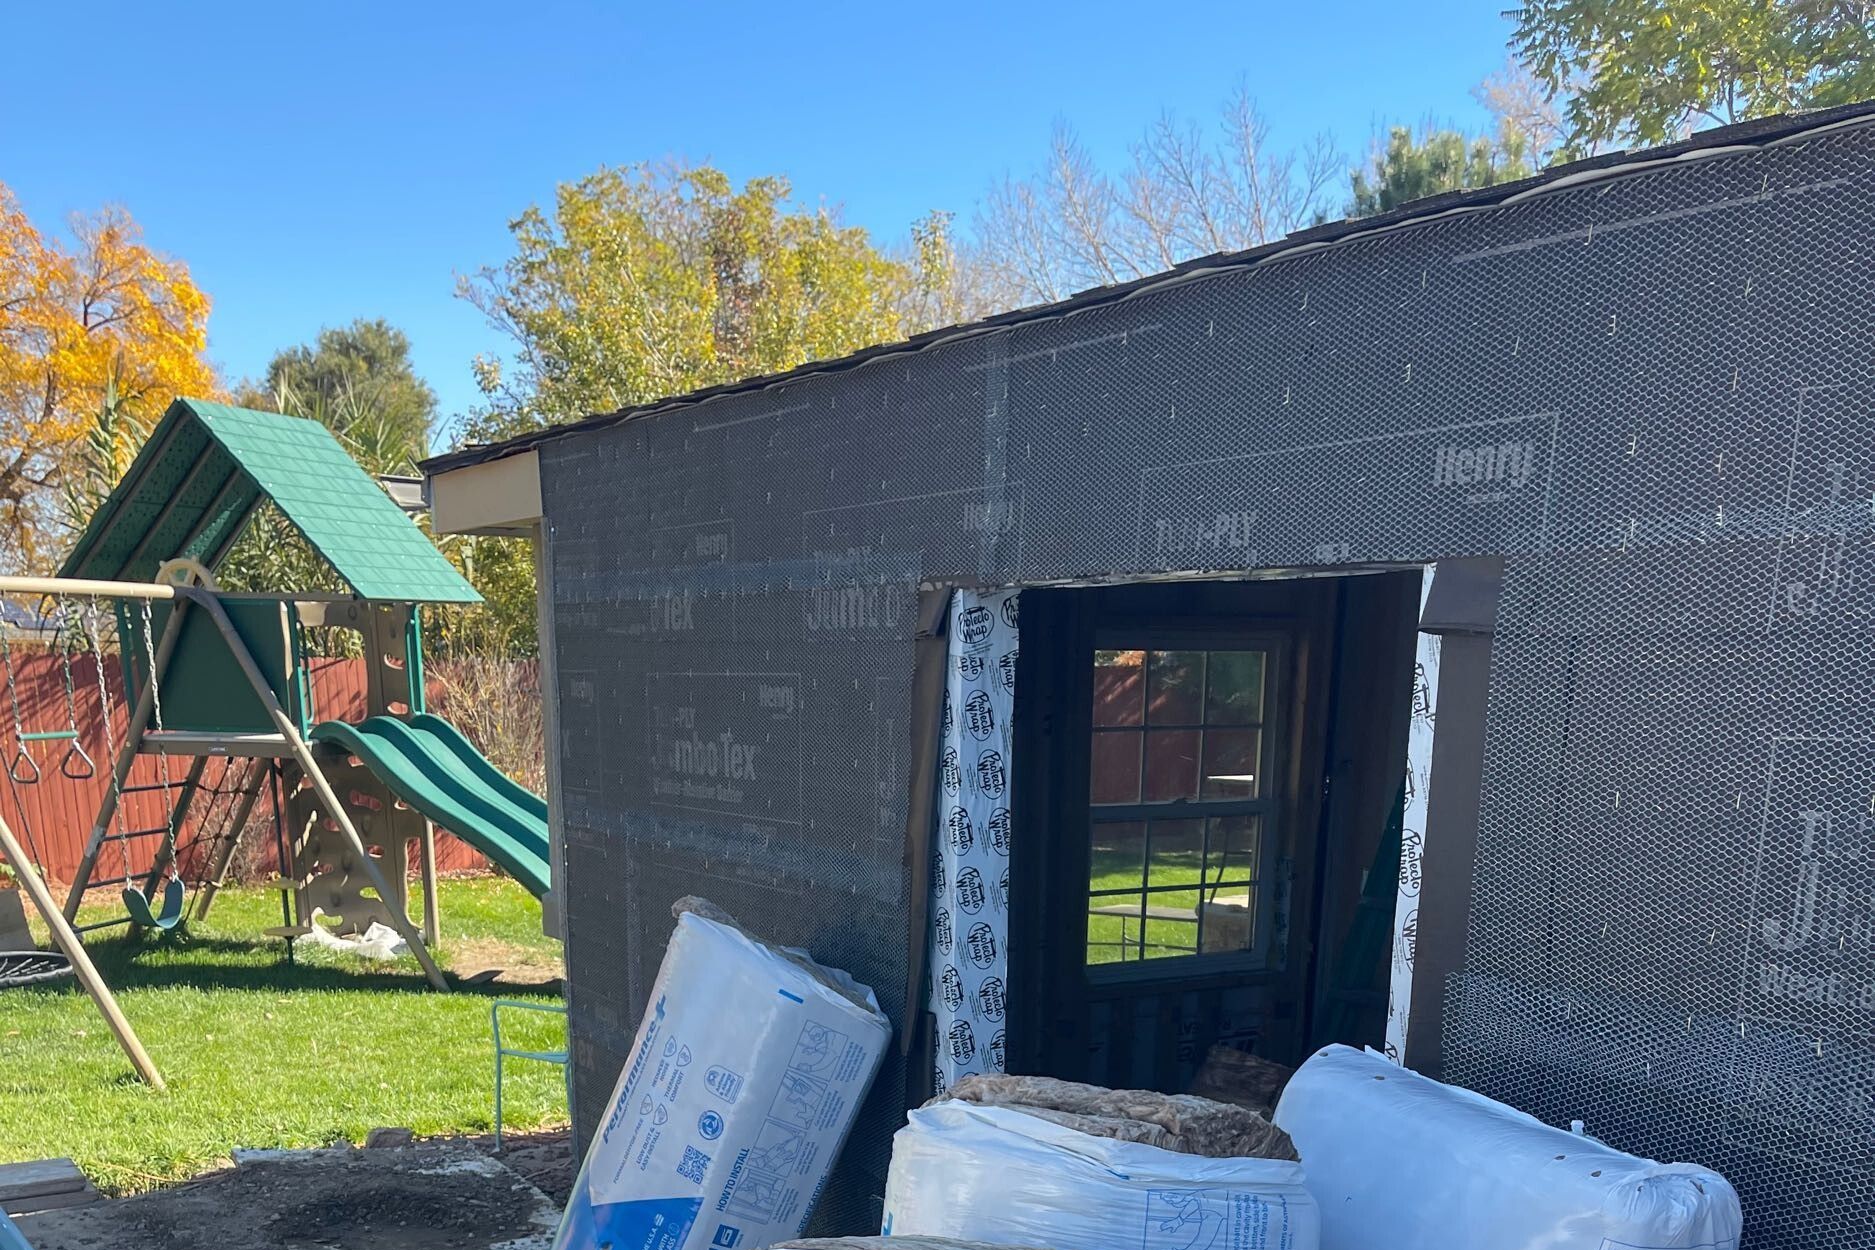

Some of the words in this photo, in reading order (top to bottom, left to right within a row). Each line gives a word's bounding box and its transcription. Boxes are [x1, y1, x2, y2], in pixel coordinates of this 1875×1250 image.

[1433, 441, 1534, 489] Henry
[959, 607, 990, 632] Protecto
[963, 625, 988, 643] Wrap
[965, 701, 980, 733] Wrap
[974, 691, 995, 736] Protecto
[977, 760, 992, 792] Wrap
[986, 751, 1006, 794] Protecto
[949, 817, 959, 847] Wrap
[953, 807, 974, 849] Protecto
[988, 817, 1003, 848] Wrap
[956, 877, 970, 907] Wrap
[965, 867, 985, 909] Protecto
[940, 909, 953, 951] Protecto
[968, 932, 983, 963] Wrap
[976, 923, 997, 964] Protecto
[947, 966, 964, 1007] Protecto
[978, 987, 994, 1017] Wrap
[988, 977, 1007, 1018] Protecto
[948, 1030, 962, 1059] Wrap
[957, 1020, 976, 1060] Protecto
[715, 1191, 731, 1212] HOW
[725, 1178, 736, 1191] TO
[731, 1147, 750, 1180] INSTALL
